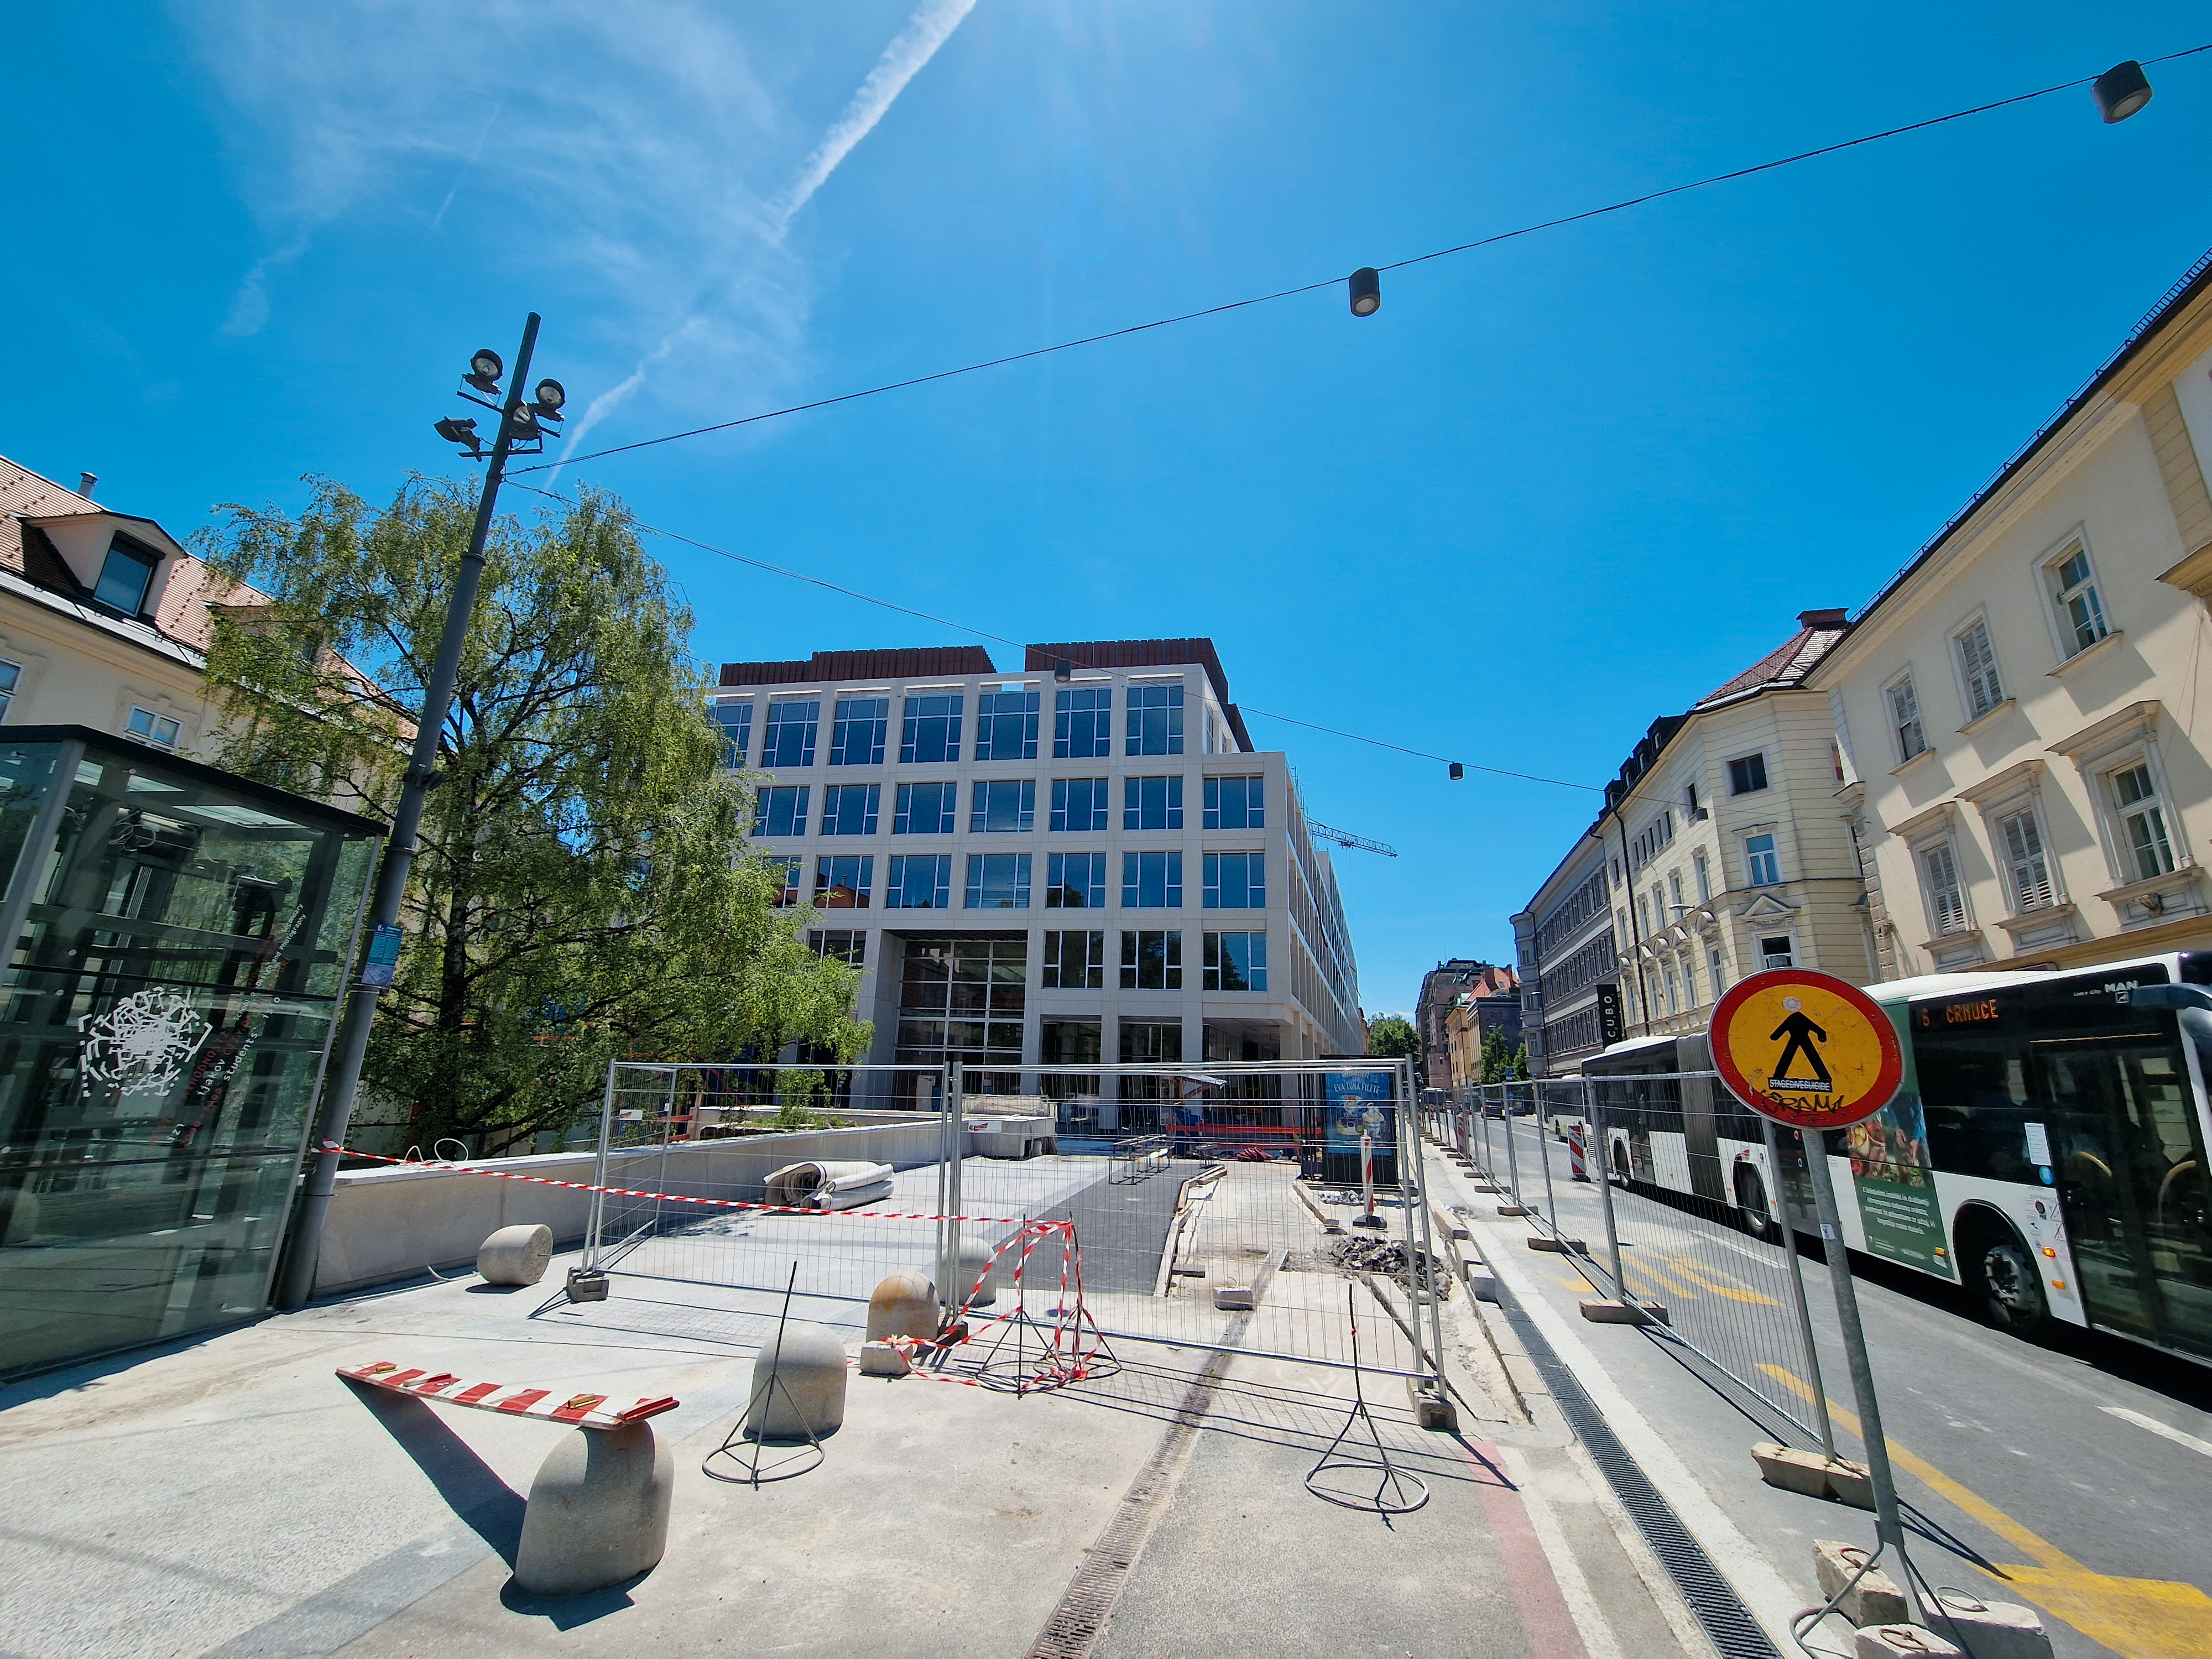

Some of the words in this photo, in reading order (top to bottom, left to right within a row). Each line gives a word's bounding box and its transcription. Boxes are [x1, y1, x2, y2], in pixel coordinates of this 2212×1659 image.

[281, 903, 304, 933] Secondary
[233, 999, 251, 1021] School
[271, 951, 281, 964] and
[279, 913, 306, 951] Photography
[2104, 980, 2138, 993] MAN
[1922, 1008, 1929, 1027] 6
[1333, 1083, 1345, 1093] EVA
[1361, 1083, 1381, 1094] FILETE
